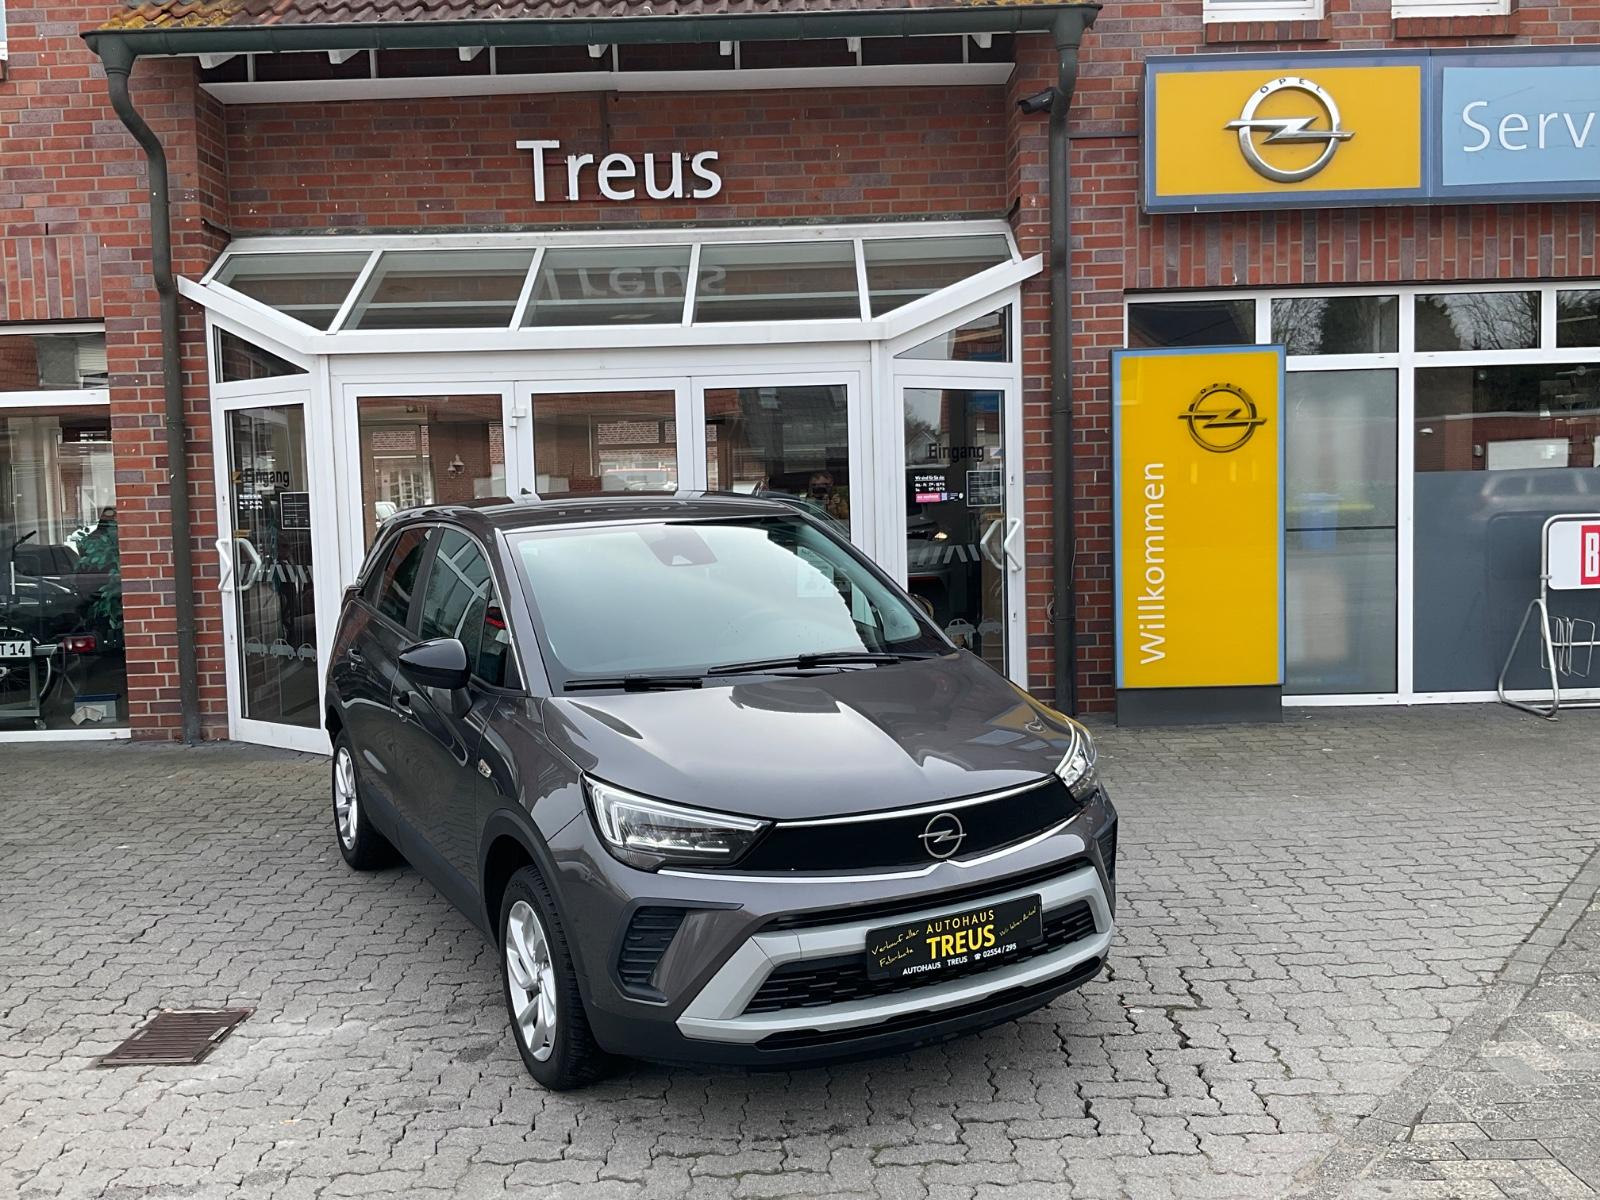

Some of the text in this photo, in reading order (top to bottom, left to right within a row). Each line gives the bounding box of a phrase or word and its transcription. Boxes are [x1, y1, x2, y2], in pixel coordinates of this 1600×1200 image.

[1260, 78, 1321, 93] OPEL
[1462, 101, 1596, 152] Serv
[516, 139, 722, 202] Treus
[1200, 383, 1242, 394] OPEL
[928, 443, 984, 463] Eingang
[243, 468, 289, 487] Eingang
[1137, 462, 1166, 664] Willkommen
[10, 643, 25, 655] 14
[927, 909, 995, 934] AUTOHAUS
[872, 934, 904, 955] Verkauf
[926, 925, 996, 959] TREUS
[902, 962, 941, 975] AUTOHAUS
[947, 956, 968, 966] TREUS
